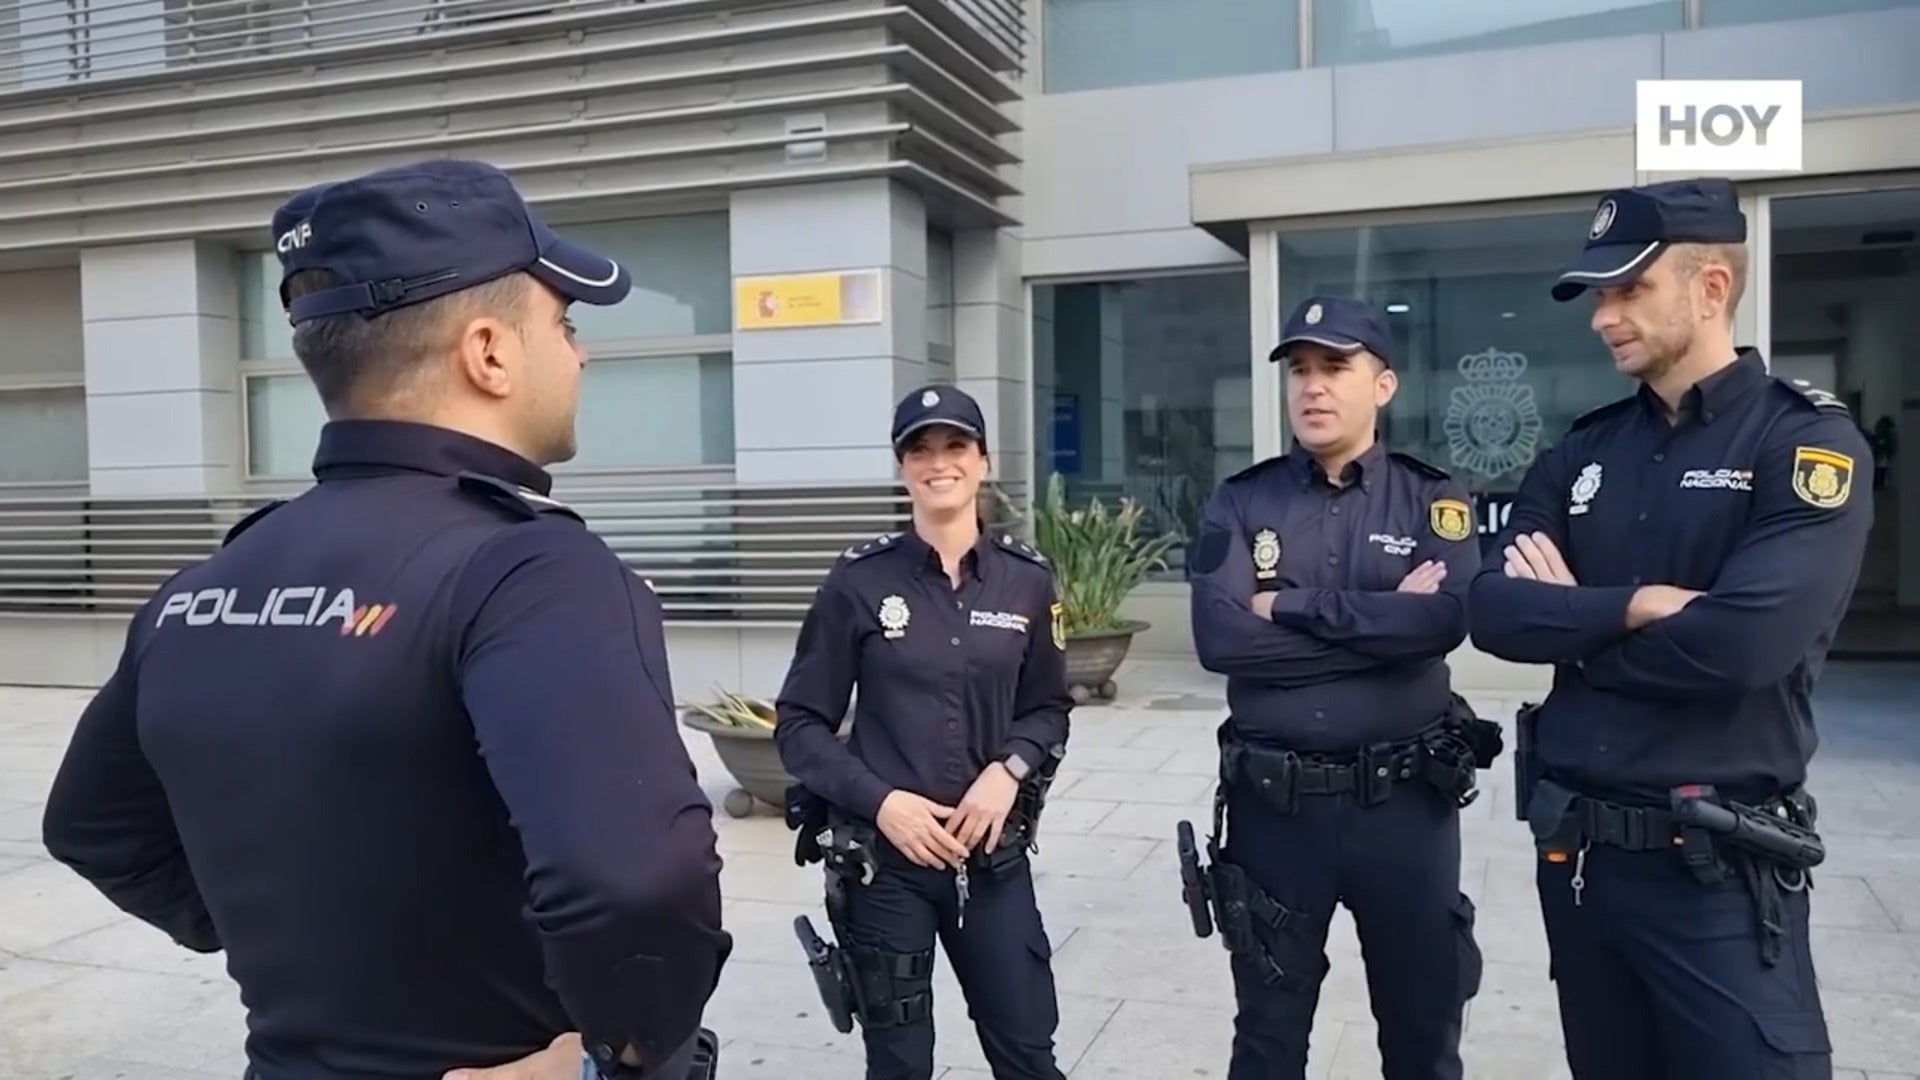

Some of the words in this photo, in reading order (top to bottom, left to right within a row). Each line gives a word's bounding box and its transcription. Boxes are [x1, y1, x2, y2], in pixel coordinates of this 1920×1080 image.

[278, 223, 312, 252] CNP
[1679, 478, 1753, 491] NACIONAL
[155, 587, 354, 629] POLICIA
